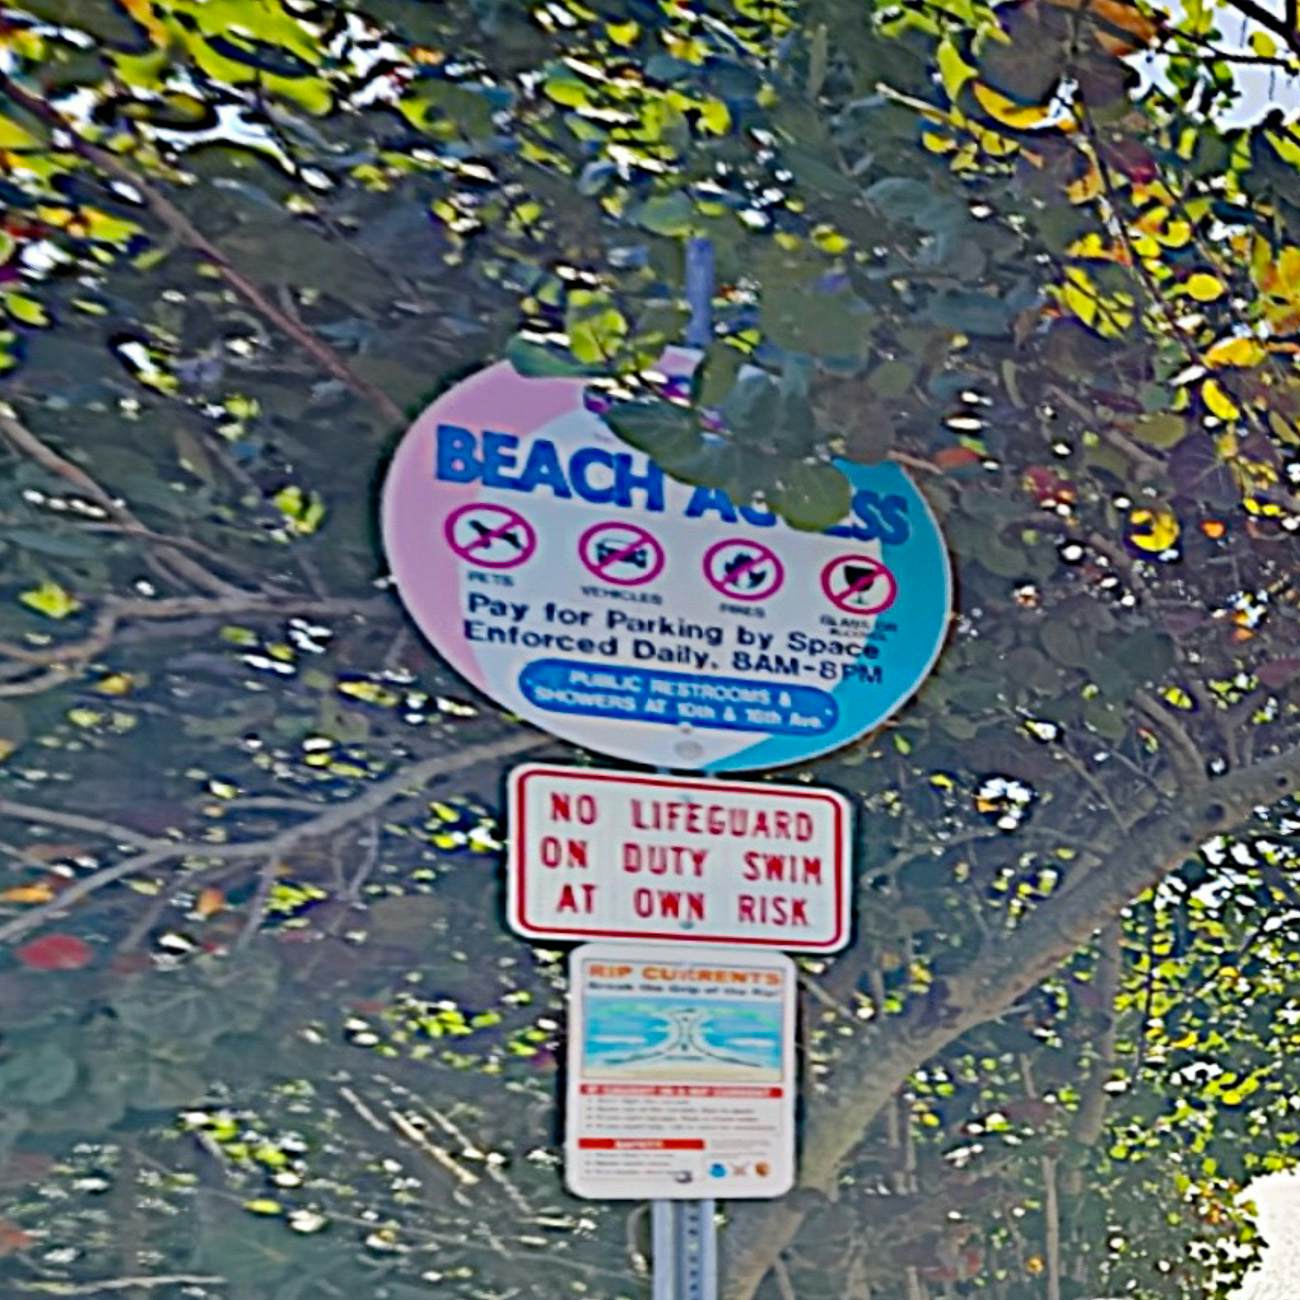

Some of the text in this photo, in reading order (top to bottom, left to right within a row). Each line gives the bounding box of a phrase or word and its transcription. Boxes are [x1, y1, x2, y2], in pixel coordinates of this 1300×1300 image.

[437, 424, 665, 512] BEACH
[469, 592, 880, 660] Pay for Parking by Space
[464, 619, 618, 656] Enforced
[732, 650, 883, 684] 8AM-8PM
[533, 685, 636, 712] SHOWERS
[569, 669, 643, 692] PUBLIC
[651, 678, 771, 706] RESTROOMS
[550, 792, 814, 842] NO LIFEGUARD
[540, 836, 822, 885] ON DUTY SWIM
[557, 883, 809, 926] AT OWN RISK
[588, 964, 781, 986] RIP CURRENTS
